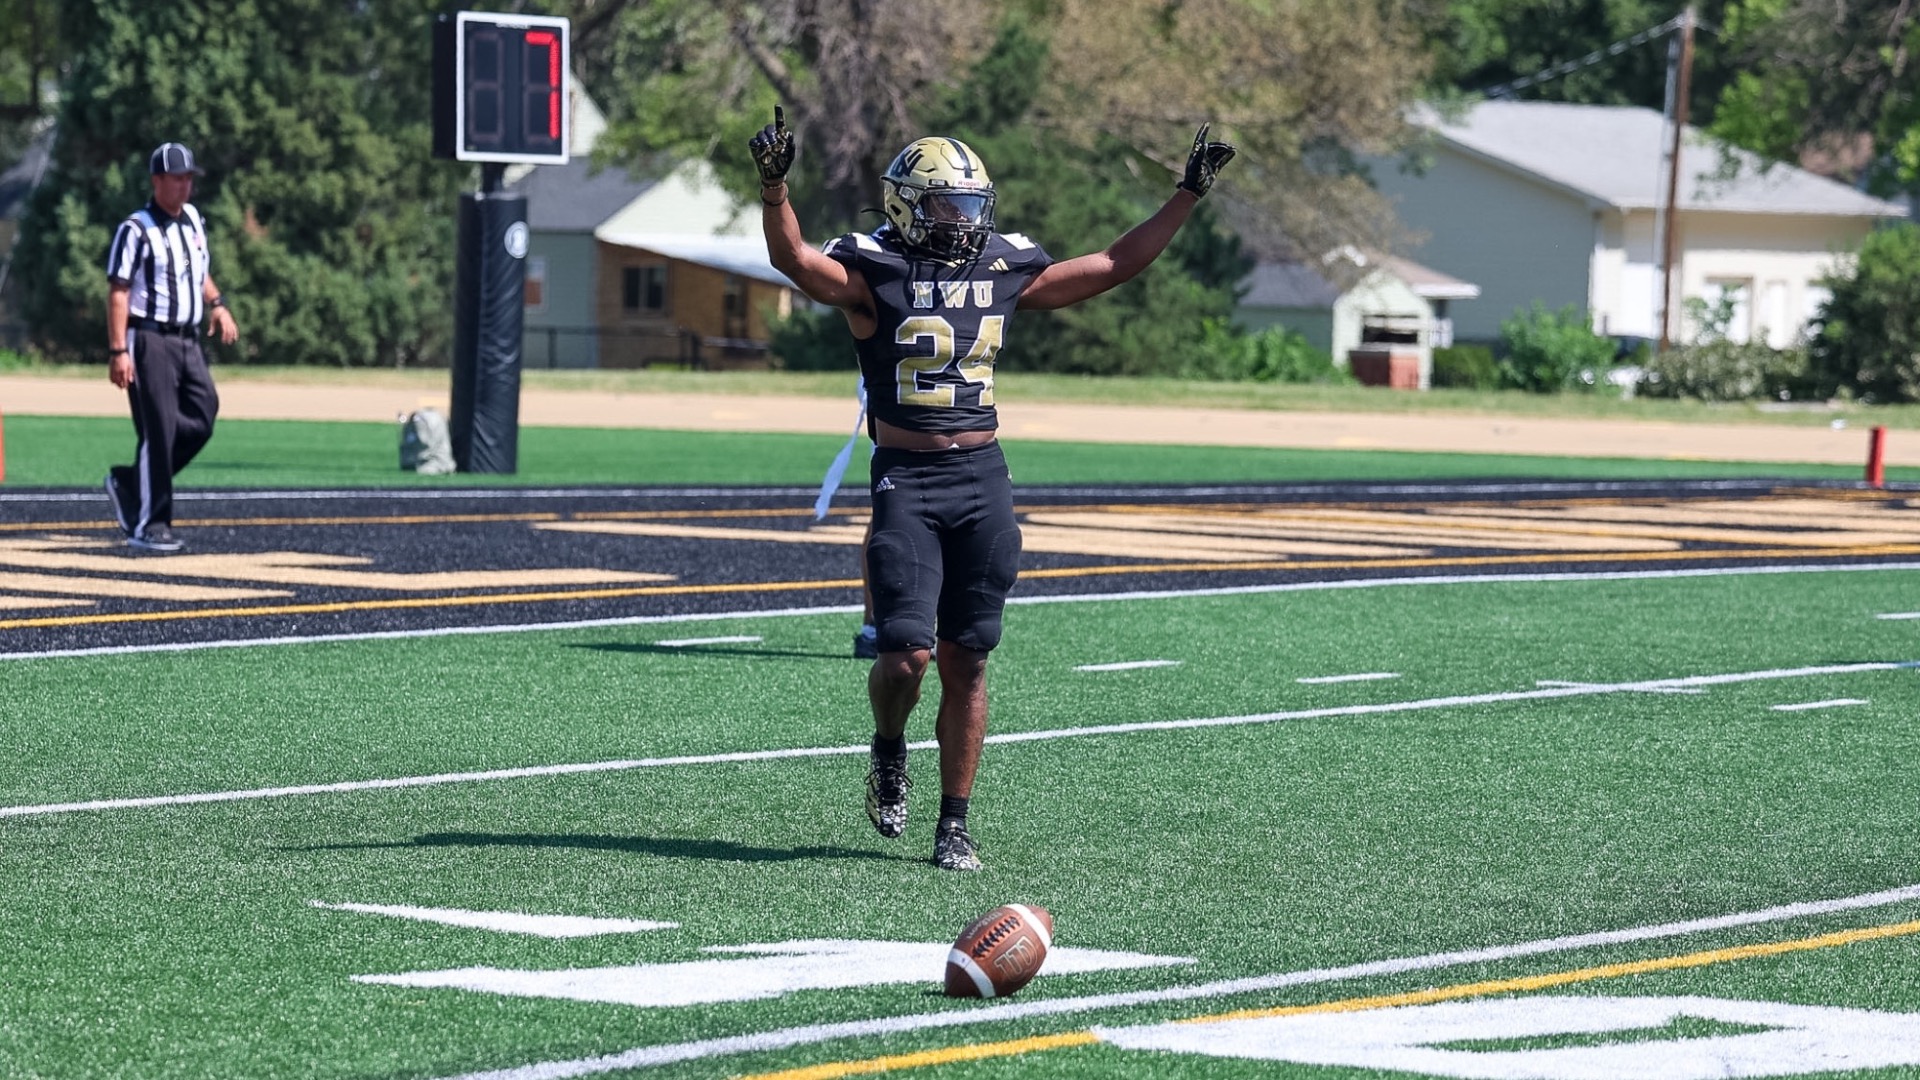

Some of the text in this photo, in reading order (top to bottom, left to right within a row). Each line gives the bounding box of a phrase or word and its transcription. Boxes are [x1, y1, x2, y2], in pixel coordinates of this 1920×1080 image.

[525, 31, 560, 139] 7
[913, 281, 994, 308] NWU
[895, 314, 1005, 407] 24
